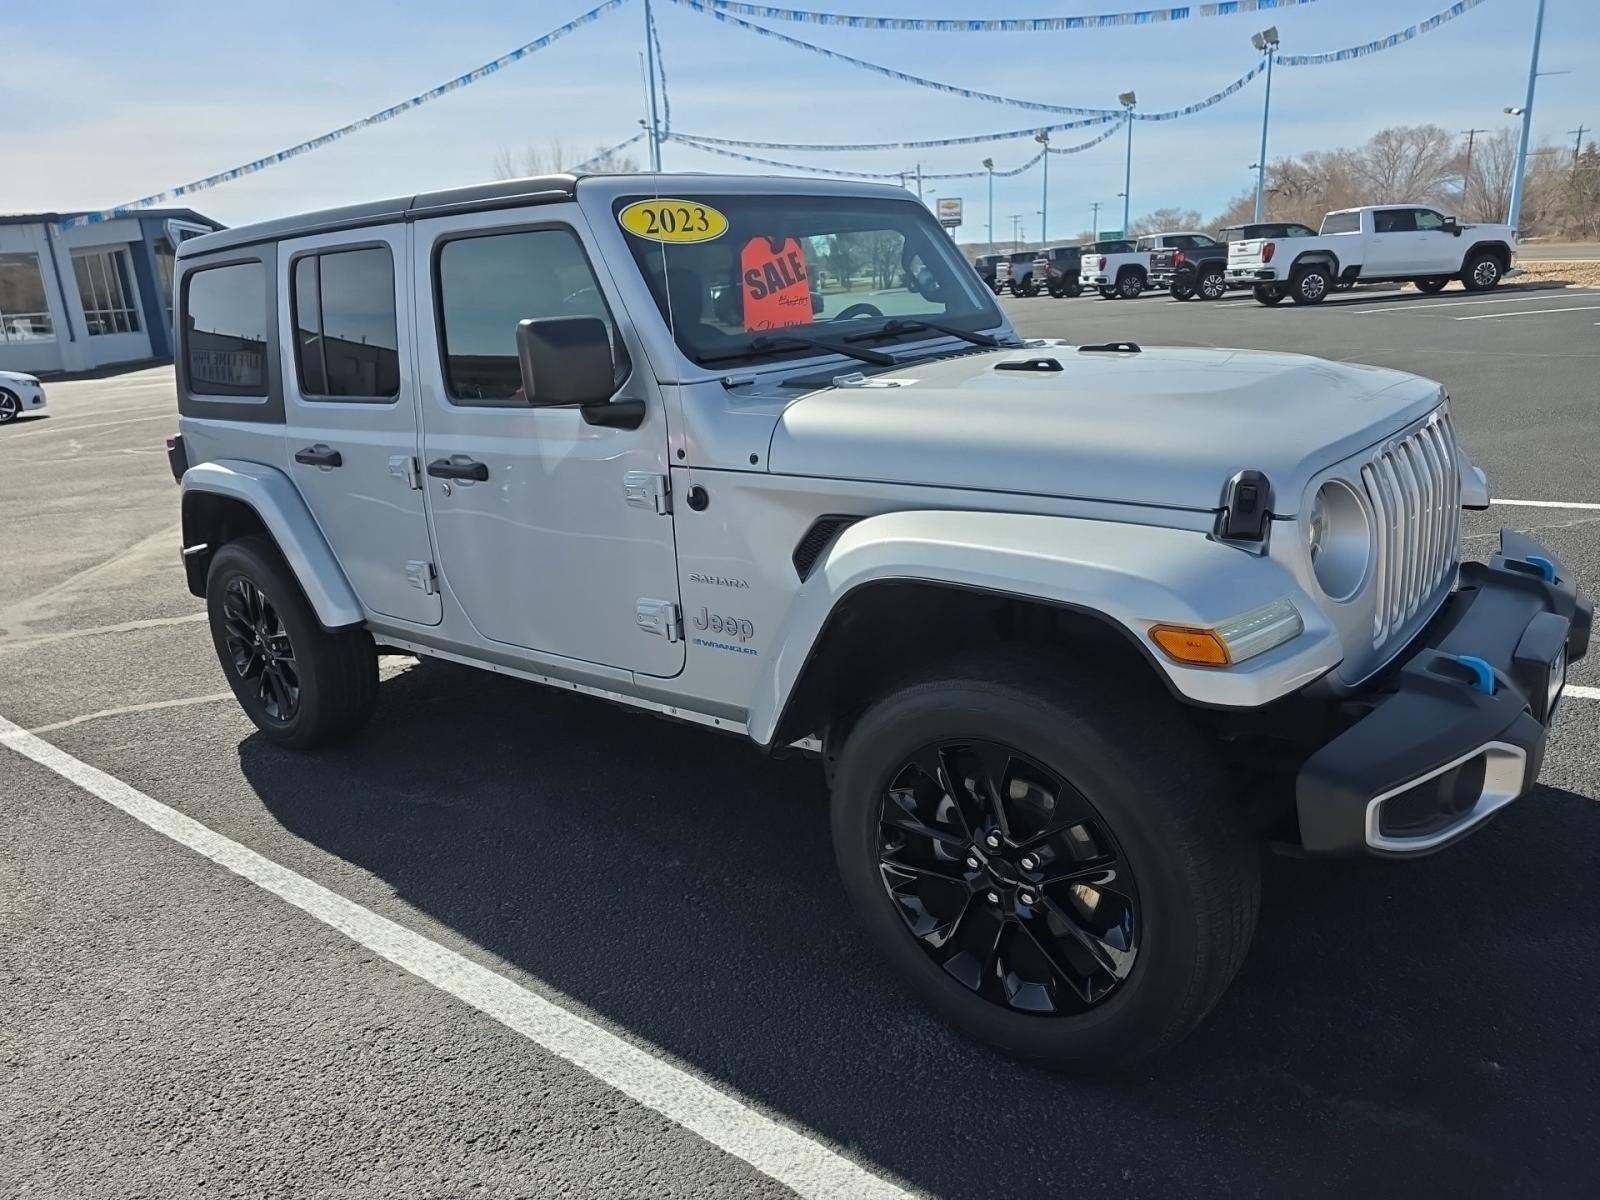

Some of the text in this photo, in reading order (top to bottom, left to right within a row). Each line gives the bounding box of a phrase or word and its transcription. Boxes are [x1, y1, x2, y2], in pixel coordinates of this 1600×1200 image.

[641, 208, 710, 234] 2023
[744, 250, 807, 301] SALE
[689, 572, 750, 589] SAHARA
[693, 606, 754, 643] Jeep
